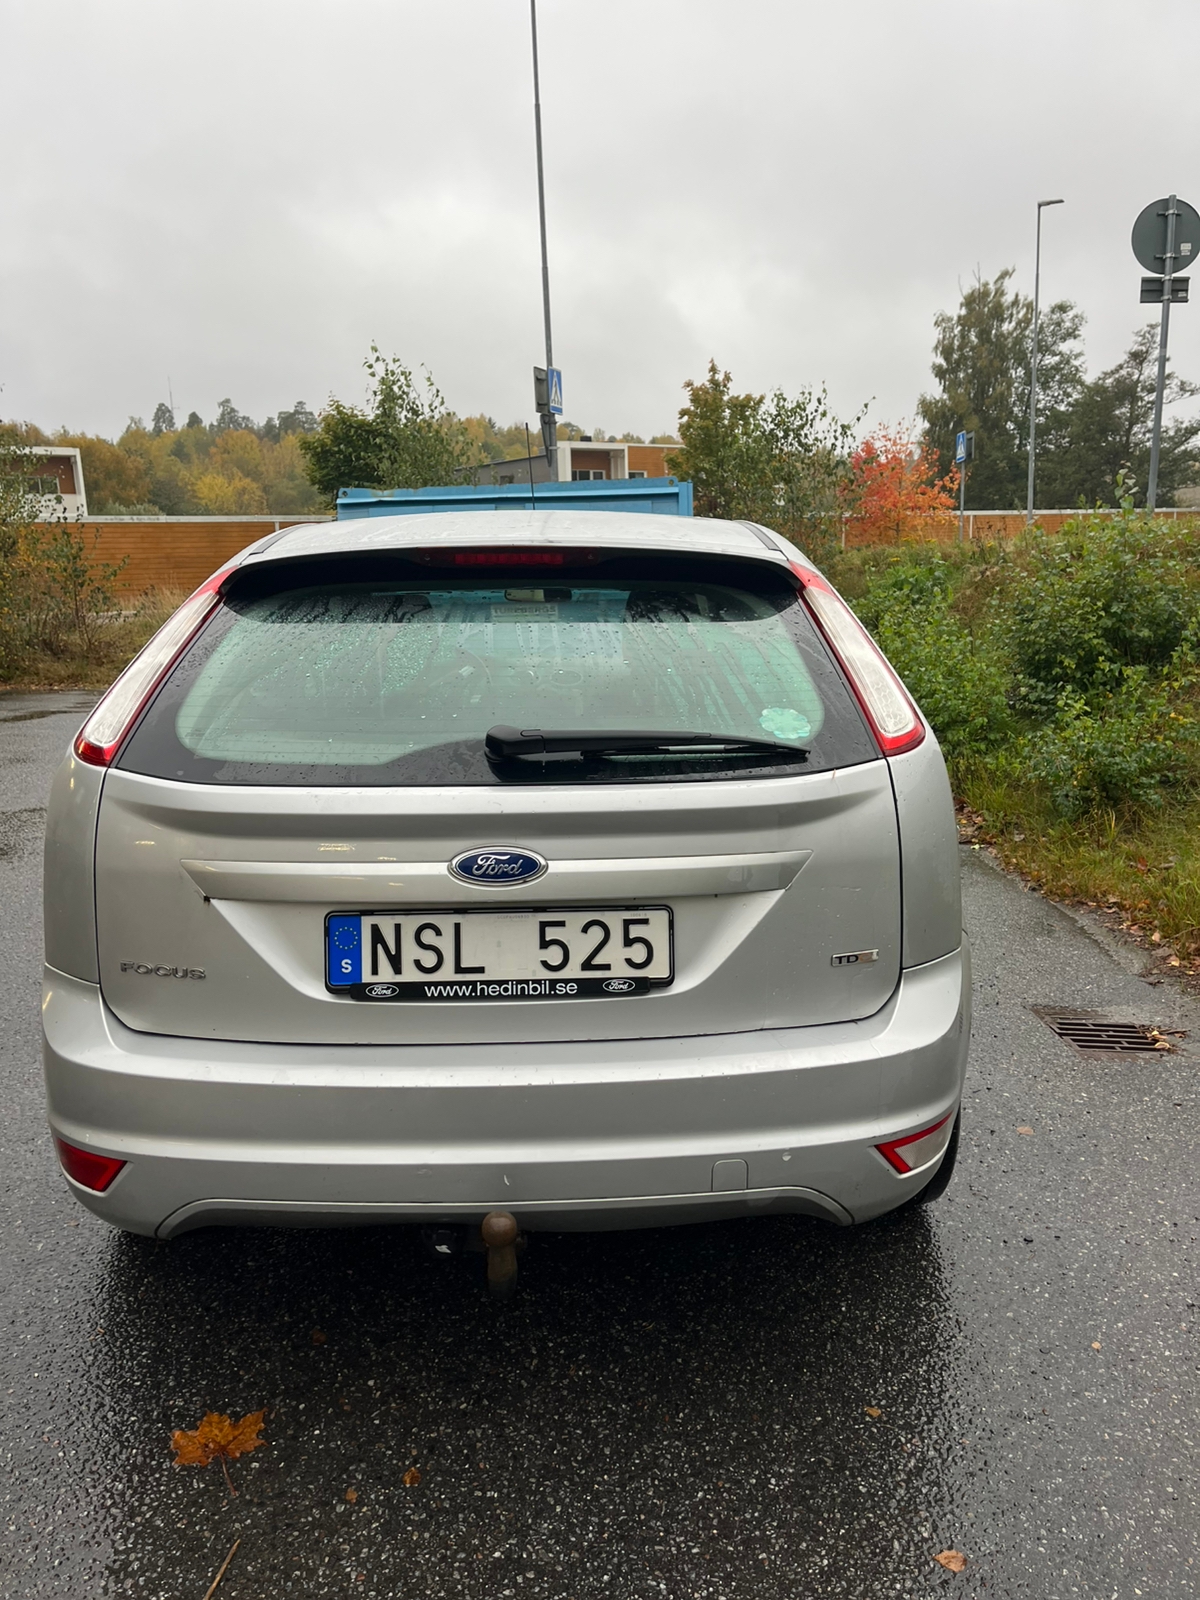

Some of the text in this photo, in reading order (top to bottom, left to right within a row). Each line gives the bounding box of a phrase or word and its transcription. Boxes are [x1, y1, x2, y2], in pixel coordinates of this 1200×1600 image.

[472, 854, 524, 875] Ford
[371, 918, 654, 976] NSL 525
[120, 960, 206, 980] FOCUS
[341, 958, 353, 973] S
[424, 980, 578, 997] www.hedinbil.se
